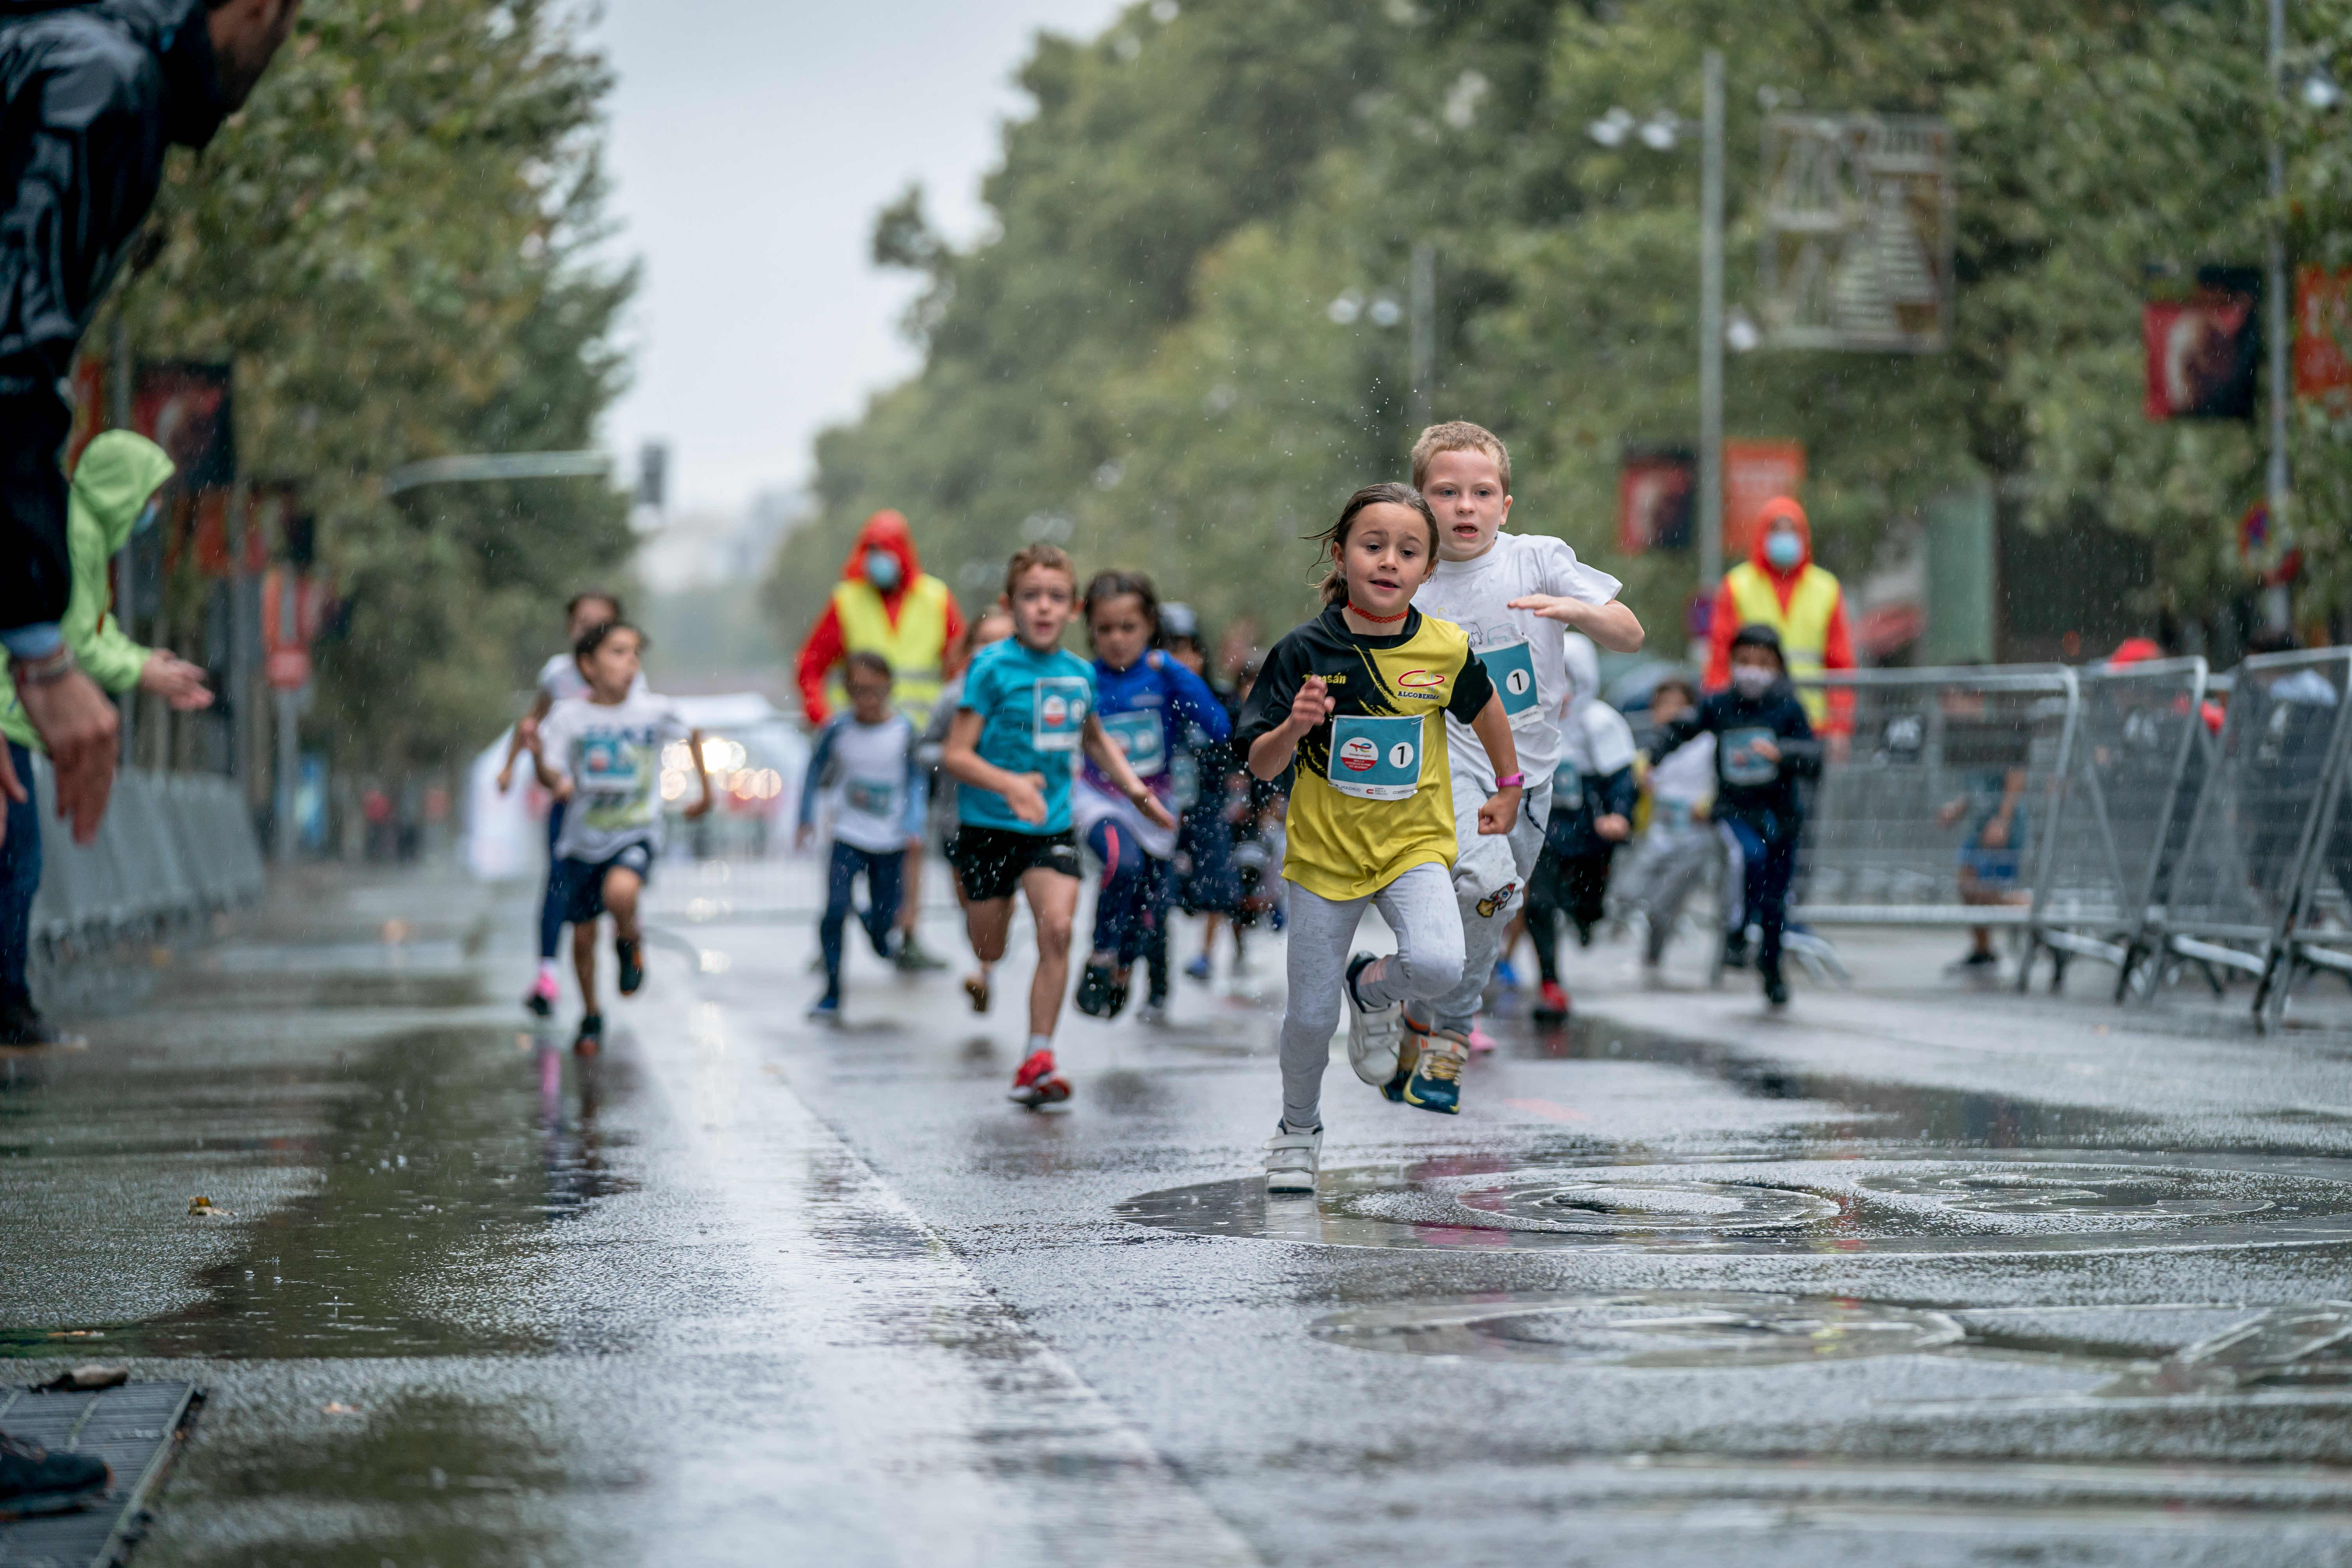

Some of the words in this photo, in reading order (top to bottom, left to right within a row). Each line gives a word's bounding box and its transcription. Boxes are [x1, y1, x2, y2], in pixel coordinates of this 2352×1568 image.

[1302, 672, 1346, 684] Tasán
[1512, 672, 1521, 691] 1
[1397, 746, 1405, 765] 1
